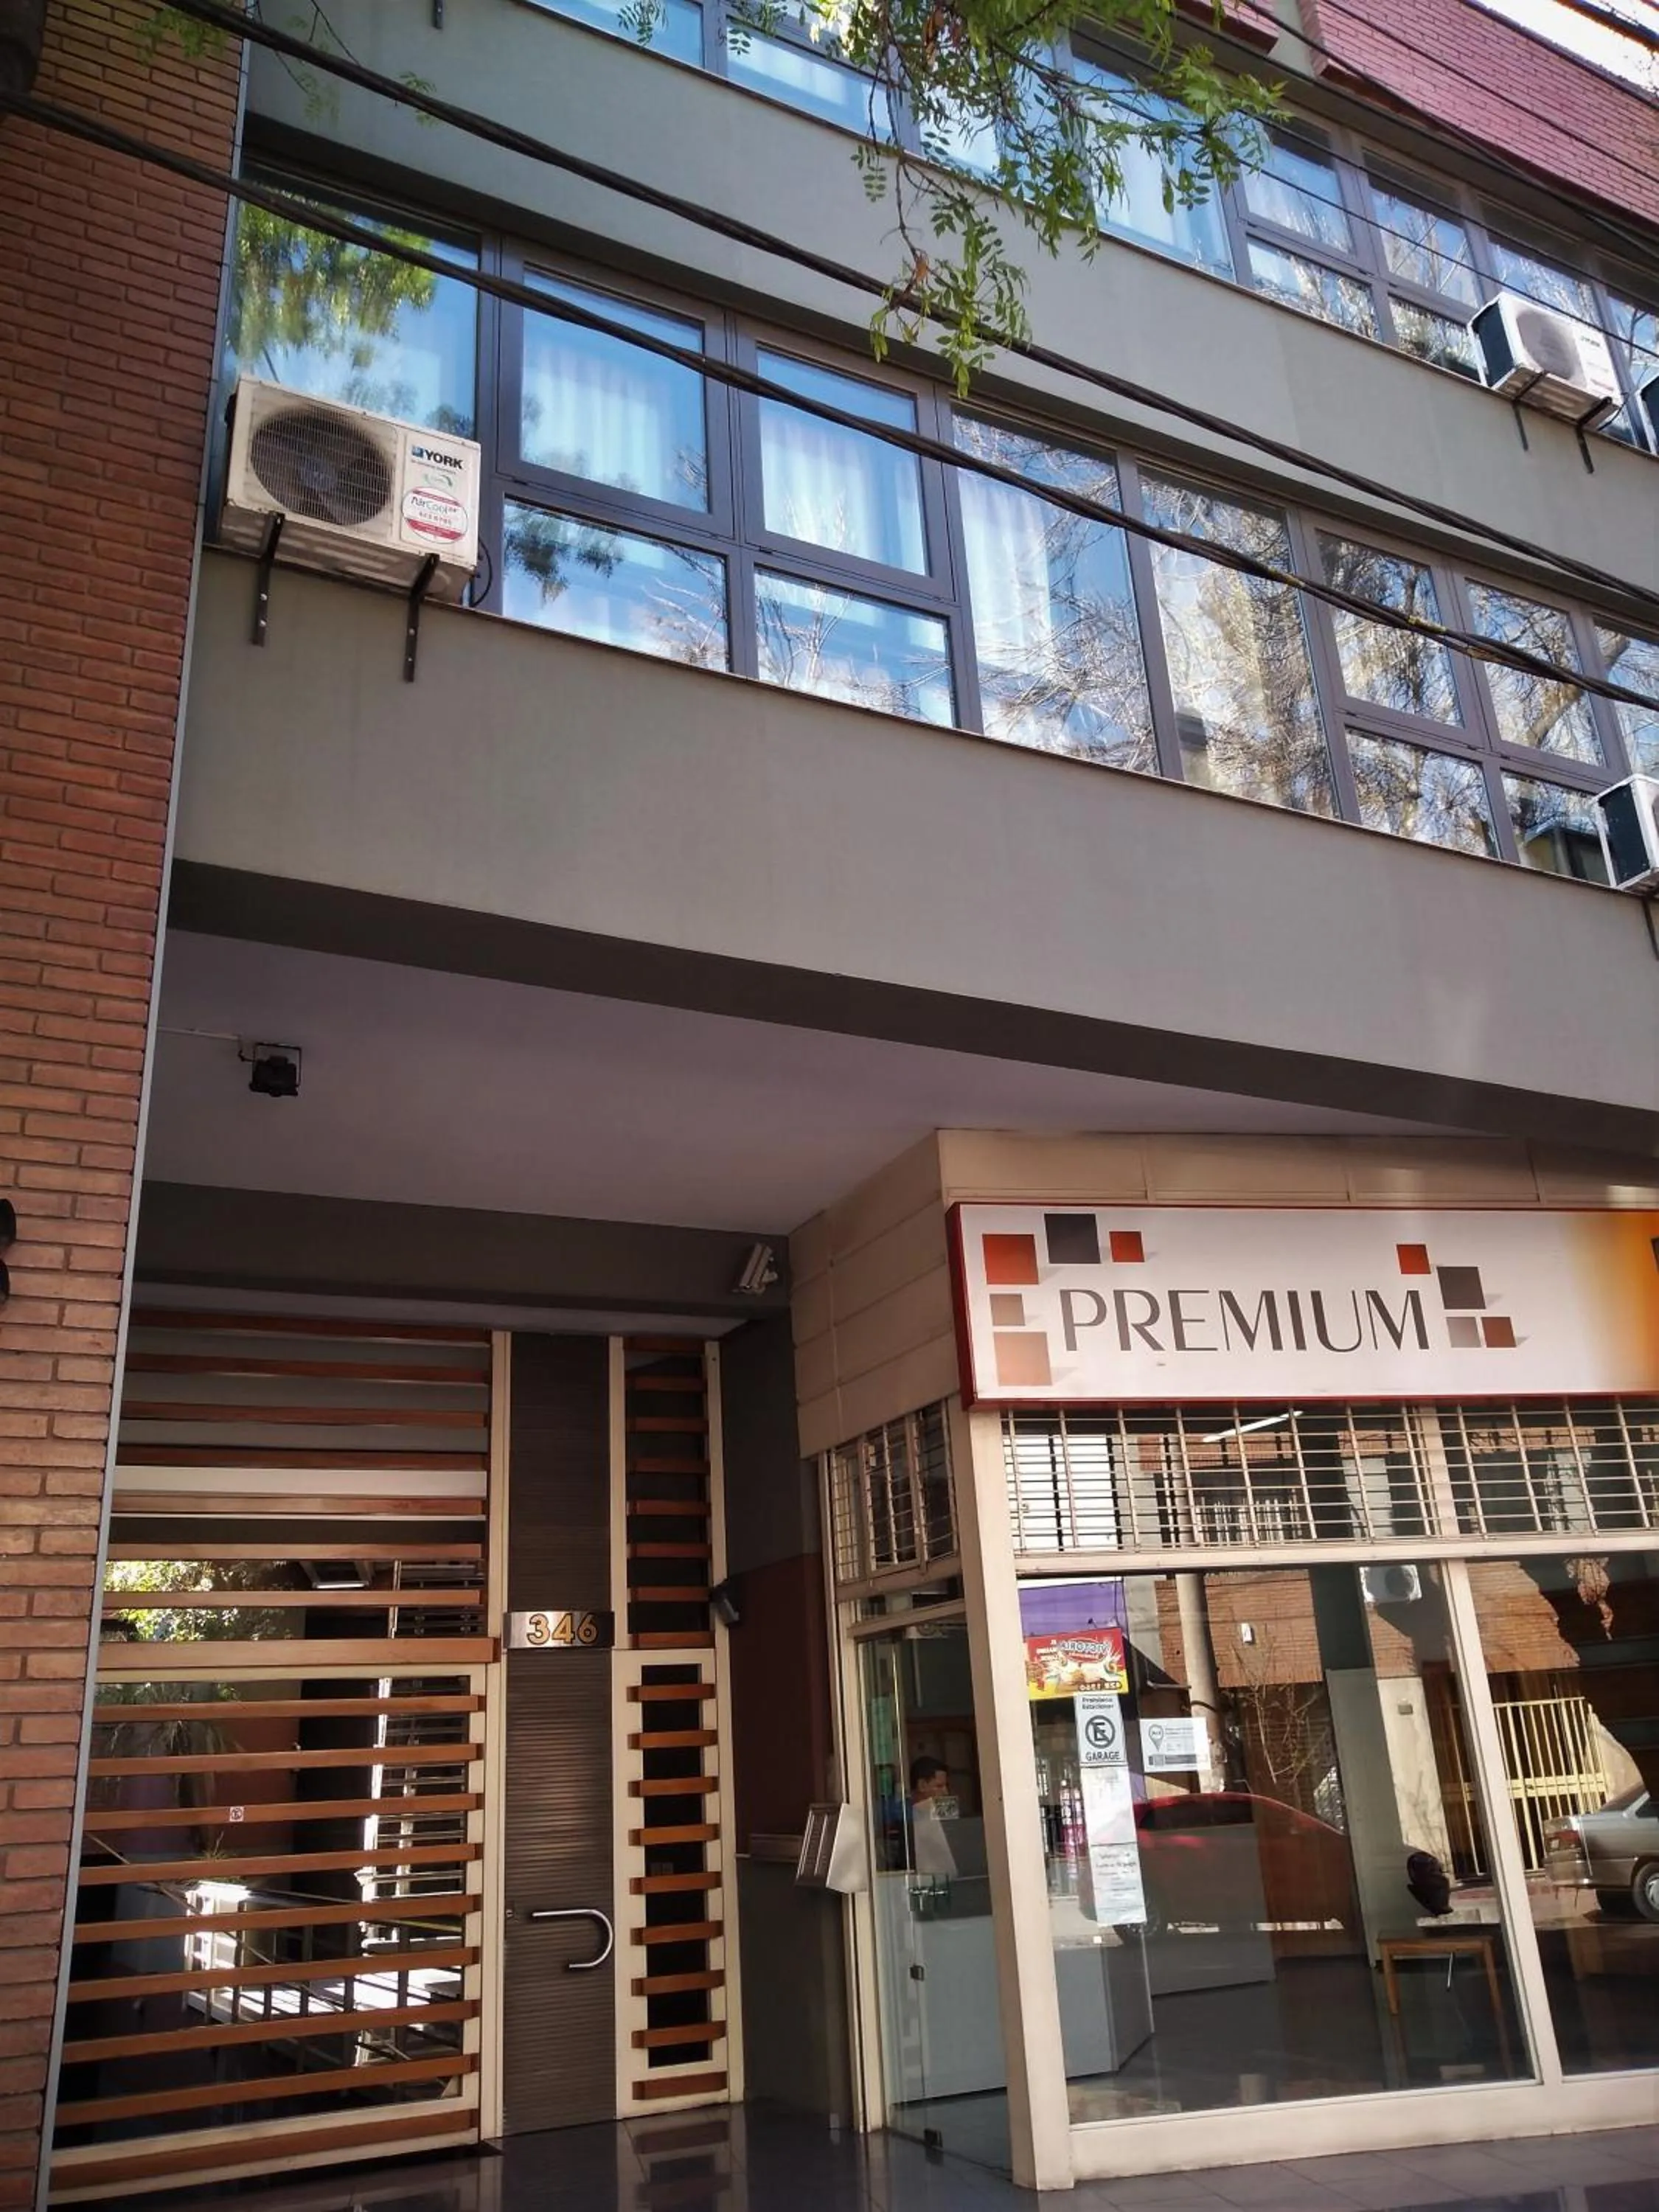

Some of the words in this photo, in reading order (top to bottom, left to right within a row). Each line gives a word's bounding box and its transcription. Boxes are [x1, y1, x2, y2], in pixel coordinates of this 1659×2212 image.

[425, 449, 464, 470] YORK
[1059, 1289, 1430, 1352] PREMIUM
[526, 1613, 599, 1646] 346
[1085, 1751, 1121, 1761] GARAGE
